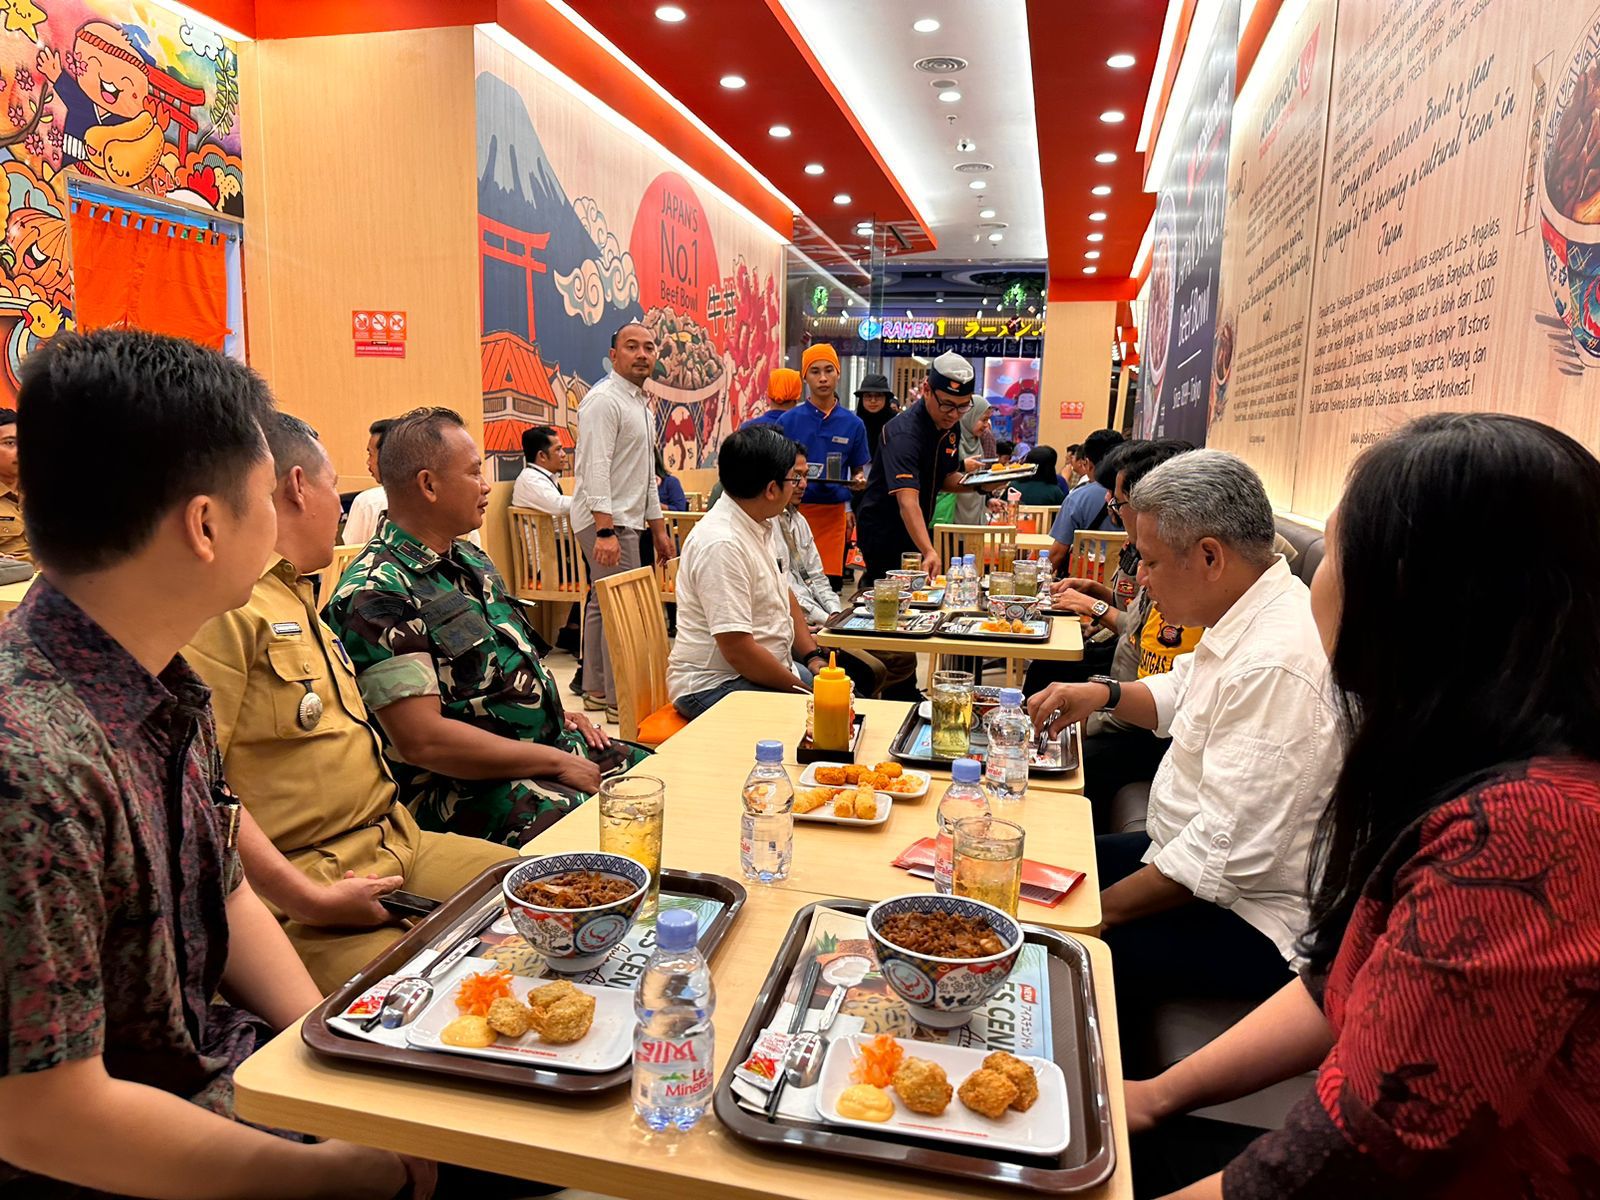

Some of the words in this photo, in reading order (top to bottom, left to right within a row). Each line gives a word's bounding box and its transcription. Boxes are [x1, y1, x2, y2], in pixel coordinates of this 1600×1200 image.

[1456, 81, 1465, 104] a
[1459, 53, 1495, 121] year
[1410, 168, 1418, 187] a
[1419, 120, 1462, 181] cultural
[1500, 86, 1516, 121] in
[661, 188, 698, 233] JAPAN'S
[661, 219, 698, 288] No.1
[1377, 220, 1404, 257] Japan
[1428, 238, 1453, 267] seperti
[1454, 234, 1467, 254] Los
[1476, 245, 1498, 273] Kuala
[660, 279, 679, 305] Beef
[680, 287, 698, 313] Bowl
[1398, 307, 1414, 329] sudah
[1416, 302, 1431, 322] hadir
[1457, 287, 1472, 309] dari
[882, 320, 935, 339] RAMEN
[936, 318, 946, 336] 1
[1396, 333, 1412, 354] sudah
[1412, 330, 1427, 349] hadir
[1434, 324, 1456, 345] hampir
[1467, 312, 1491, 336] store
[1447, 346, 1470, 371] Malang
[1472, 342, 1487, 364] dan
[1023, 986, 1033, 1001] NEW
[692, 1068, 706, 1082] Le
